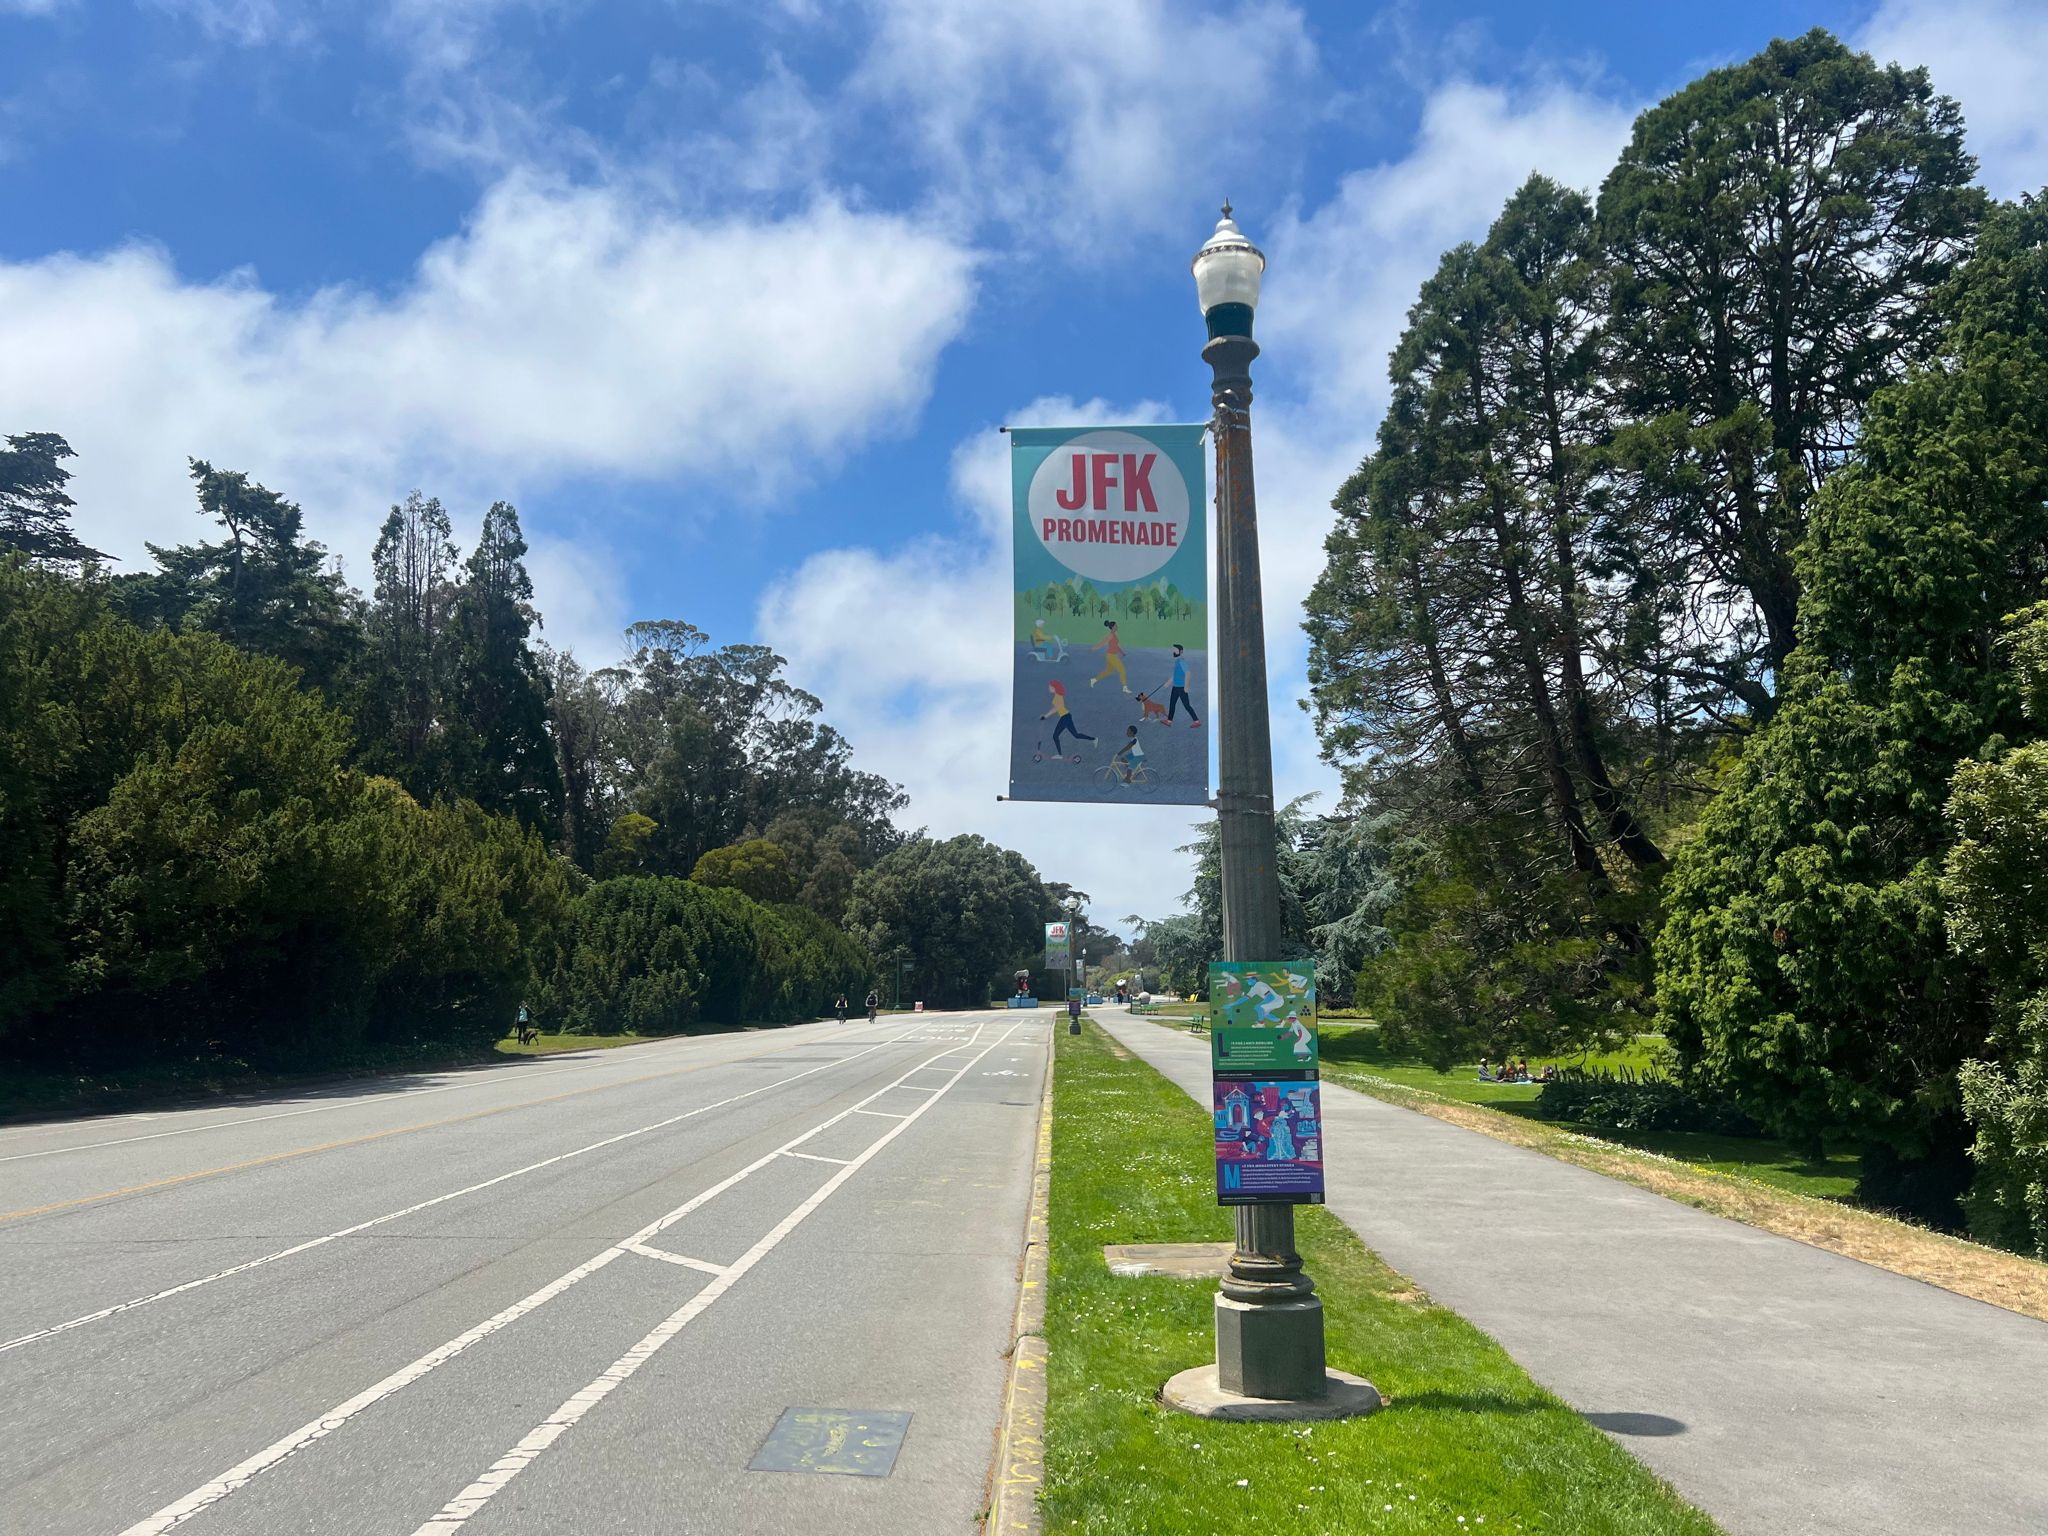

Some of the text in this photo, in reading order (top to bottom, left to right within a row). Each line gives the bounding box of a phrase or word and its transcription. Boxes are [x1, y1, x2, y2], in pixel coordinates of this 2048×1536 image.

[1056, 453, 1159, 513] JFK
[1043, 518, 1177, 547] PROMENADE
[1051, 925, 1065, 934] JFK
[1218, 1033, 1229, 1057] L
[1224, 1164, 1240, 1188] M
